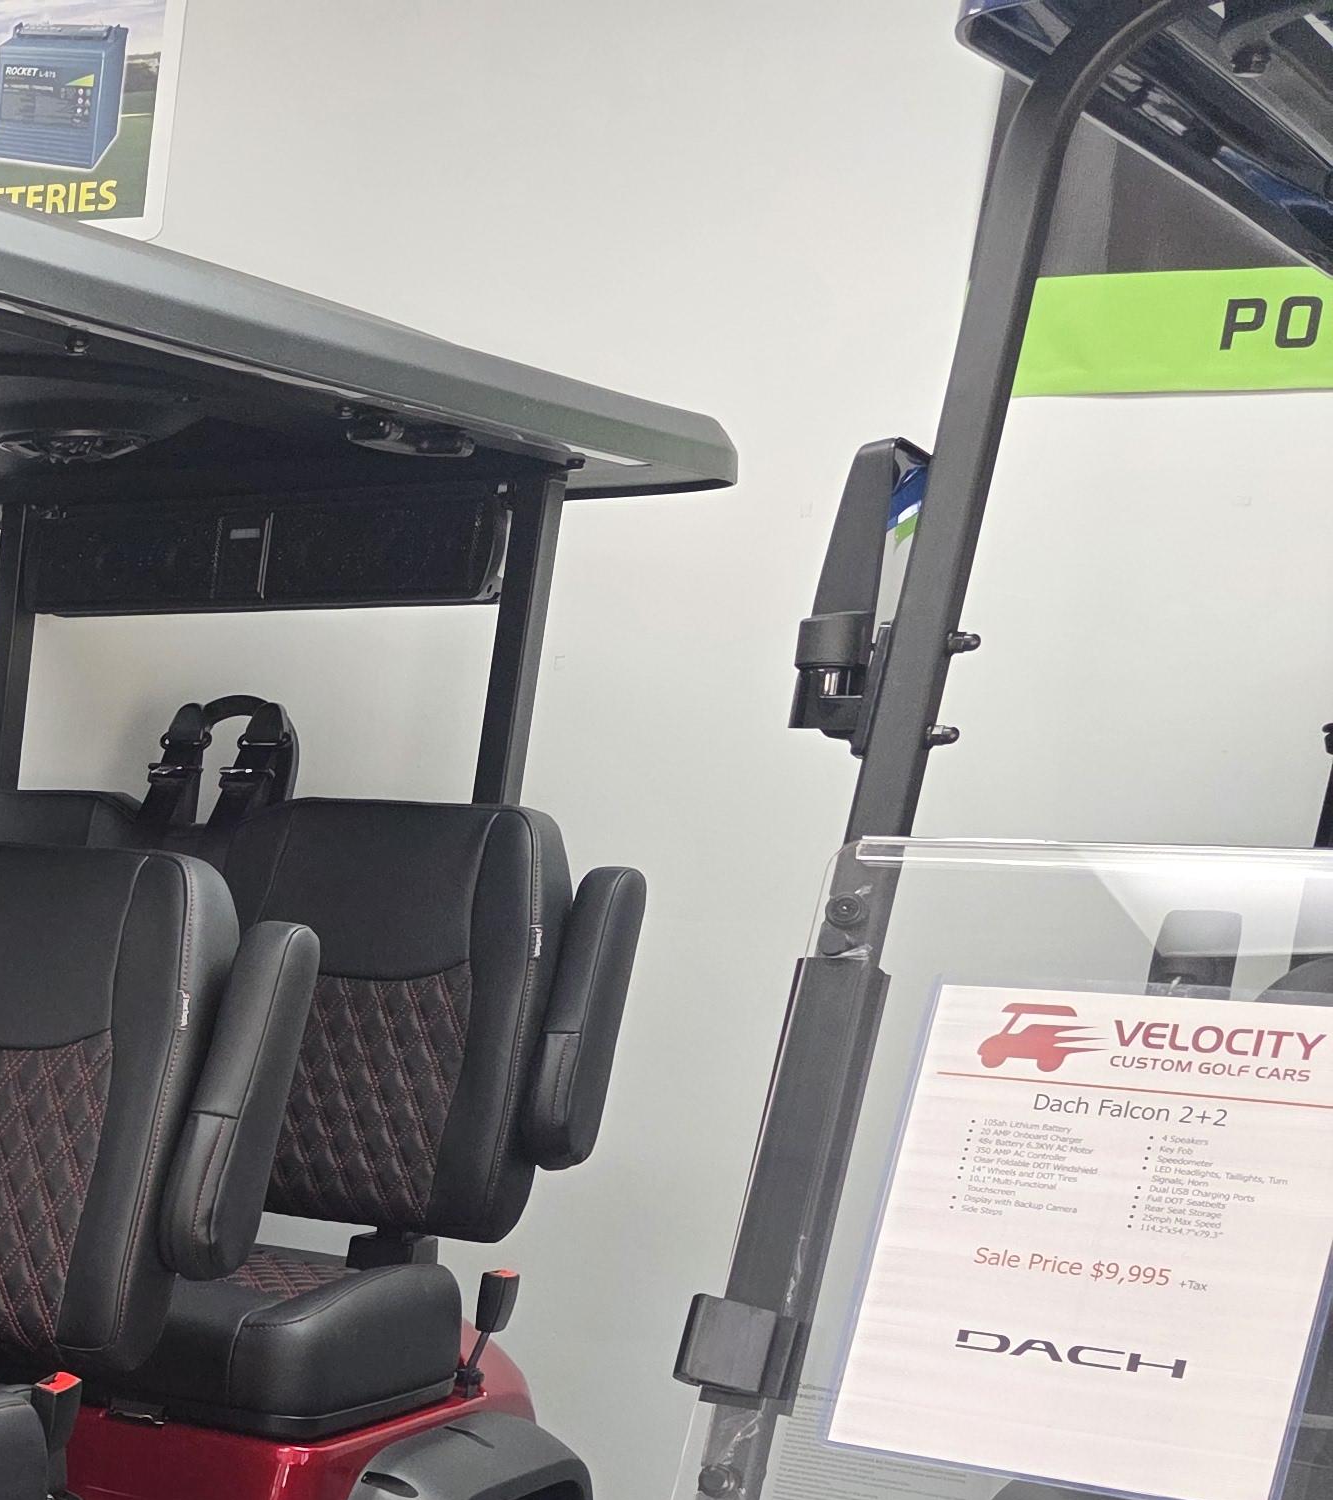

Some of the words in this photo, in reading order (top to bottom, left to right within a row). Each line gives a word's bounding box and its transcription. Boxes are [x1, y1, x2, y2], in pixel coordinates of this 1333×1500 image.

[4, 66, 39, 77] ROCKET
[1113, 1019, 1328, 1061] VELOCITY
[1109, 1055, 1193, 1074] CUSTOM
[1197, 1061, 1251, 1078] GOLF
[1255, 1066, 1312, 1083] CARS
[1033, 1093, 1090, 1116] Dach
[1097, 1098, 1171, 1122] Falcon
[1178, 1105, 1229, 1128] 2+2
[1009, 1120, 1039, 1131] Lithium
[1042, 1123, 1072, 1134] Battery
[980, 1128, 991, 1136] 20
[992, 1129, 1011, 1137] AMP
[1013, 1130, 1048, 1141] Onboard
[1050, 1134, 1084, 1144] Charger
[1170, 1135, 1209, 1146] Speakers
[995, 1138, 1024, 1149] Battery
[1056, 1144, 1068, 1152] AC
[1069, 1146, 1094, 1155] Motor
[1159, 1145, 1175, 1154] Key
[1177, 1146, 1194, 1155] Fob
[993, 1148, 1012, 1156] AMP
[1013, 1150, 1025, 1158] AC
[1027, 1151, 1068, 1162] Controller
[1157, 1155, 1214, 1168] Speedometer
[973, 1155, 995, 1164] Clear
[996, 1157, 1031, 1168] Foldable
[1032, 1161, 1052, 1170] DOT
[1053, 1163, 1099, 1175] Windshield
[987, 1166, 1017, 1176] Wheels
[1018, 1170, 1034, 1178] and
[1035, 1171, 1056, 1180] DOT
[1057, 1174, 1078, 1183] Tires
[1151, 1175, 1184, 1186] Signals,
[1187, 1178, 1209, 1187] Horn
[1154, 1165, 1172, 1174] LED
[1174, 1167, 1221, 1179] Headlights,
[1225, 1171, 1264, 1184] Taillights,
[1268, 1176, 1288, 1185] Turn
[966, 1184, 1016, 1196] Touchscreen
[992, 1177, 1057, 1190] Multi-Functional
[1149, 1185, 1169, 1194] Dual
[1171, 1187, 1190, 1195] USB
[1191, 1189, 1230, 1201] Charging
[1232, 1193, 1255, 1203] Ports
[961, 1204, 978, 1213] Side
[980, 1206, 1003, 1216] Steps
[963, 1194, 993, 1205] Display
[994, 1197, 1012, 1207] with
[1014, 1200, 1044, 1210] Backup
[1045, 1203, 1078, 1214] Camera
[1146, 1195, 1162, 1203] Full
[1164, 1197, 1183, 1205] DOT
[1186, 1199, 1226, 1210] Seatbelts
[1144, 1204, 1164, 1213] Rear
[1167, 1206, 1186, 1215] Seat
[1188, 1208, 1222, 1219] Storage
[1174, 1217, 1192, 1226] Max
[1194, 1219, 1221, 1230] Speed
[973, 1247, 1021, 1269] Sale
[1028, 1253, 1083, 1276] Price
[1090, 1260, 1172, 1287] $9,995
[1178, 1279, 1209, 1292] +Tax
[955, 1329, 1187, 1379] DACH
